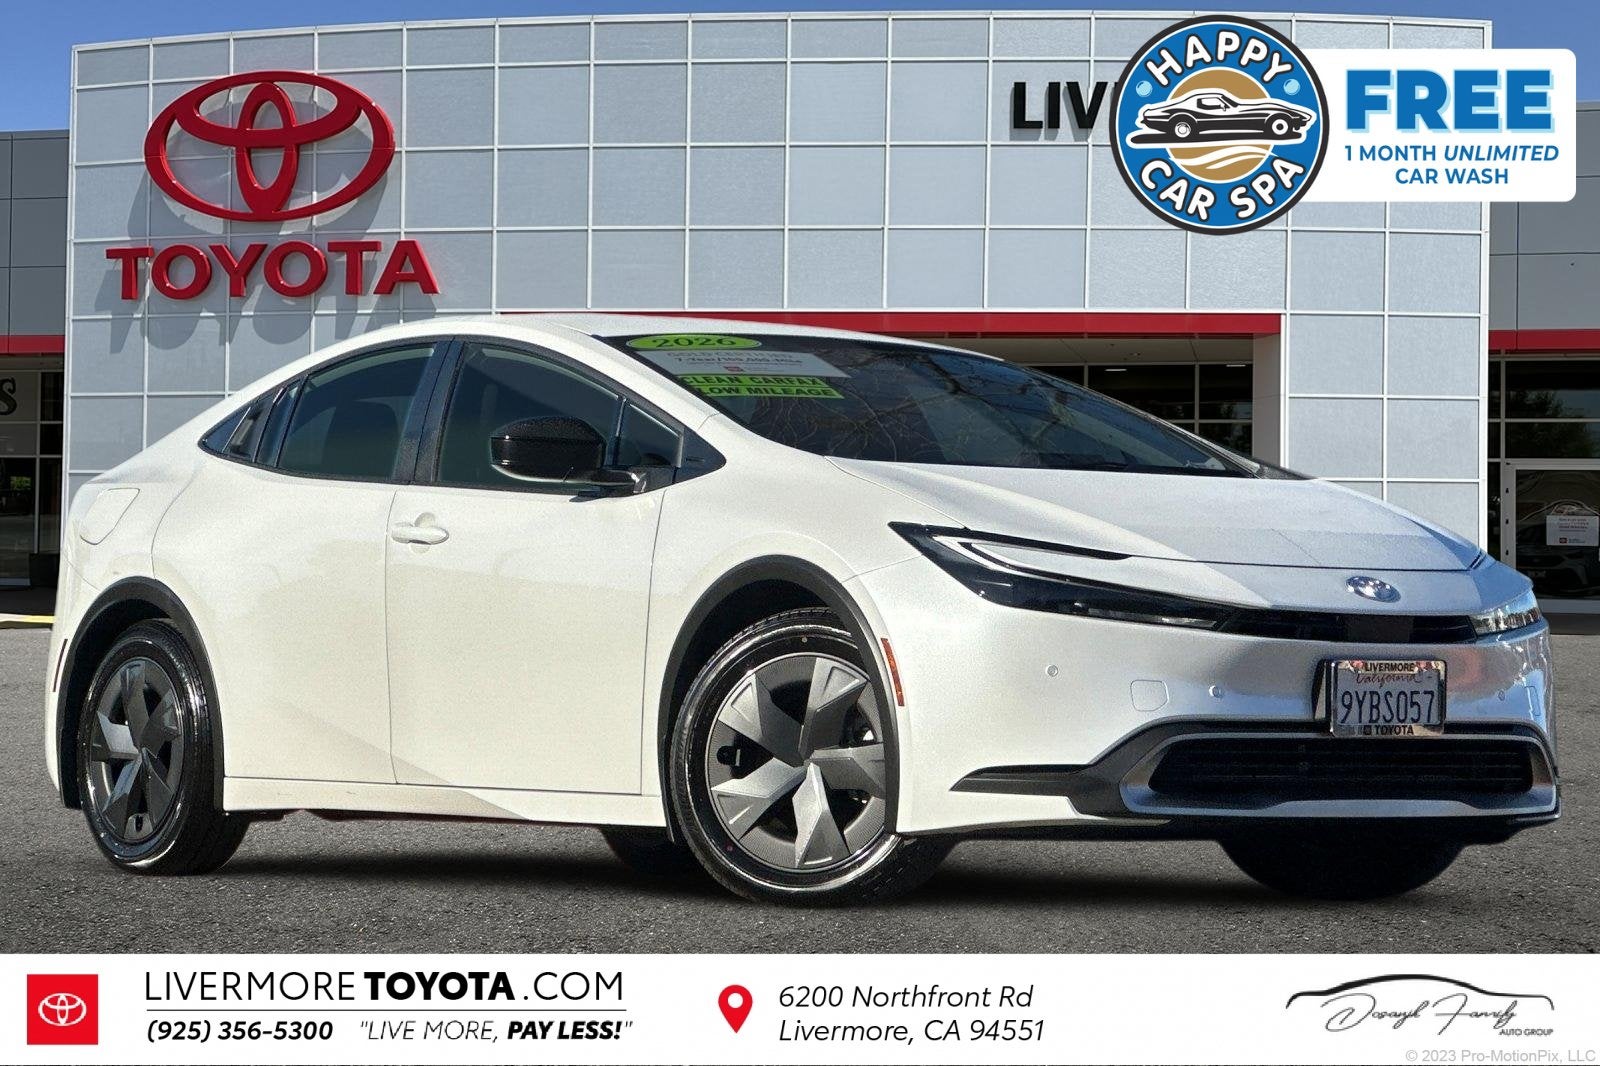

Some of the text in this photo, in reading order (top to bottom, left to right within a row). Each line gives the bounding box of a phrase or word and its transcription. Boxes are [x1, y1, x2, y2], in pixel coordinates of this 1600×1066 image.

[1013, 81, 1118, 130] LIV
[105, 239, 441, 301] TOYOTA
[652, 337, 737, 348] 2026
[749, 376, 824, 386] CARFAX
[747, 386, 837, 396] MILEAGE
[1365, 662, 1415, 672] LIVERMORE
[1340, 690, 1435, 724] 9YBS057
[1374, 724, 1414, 735] TOYOTA
